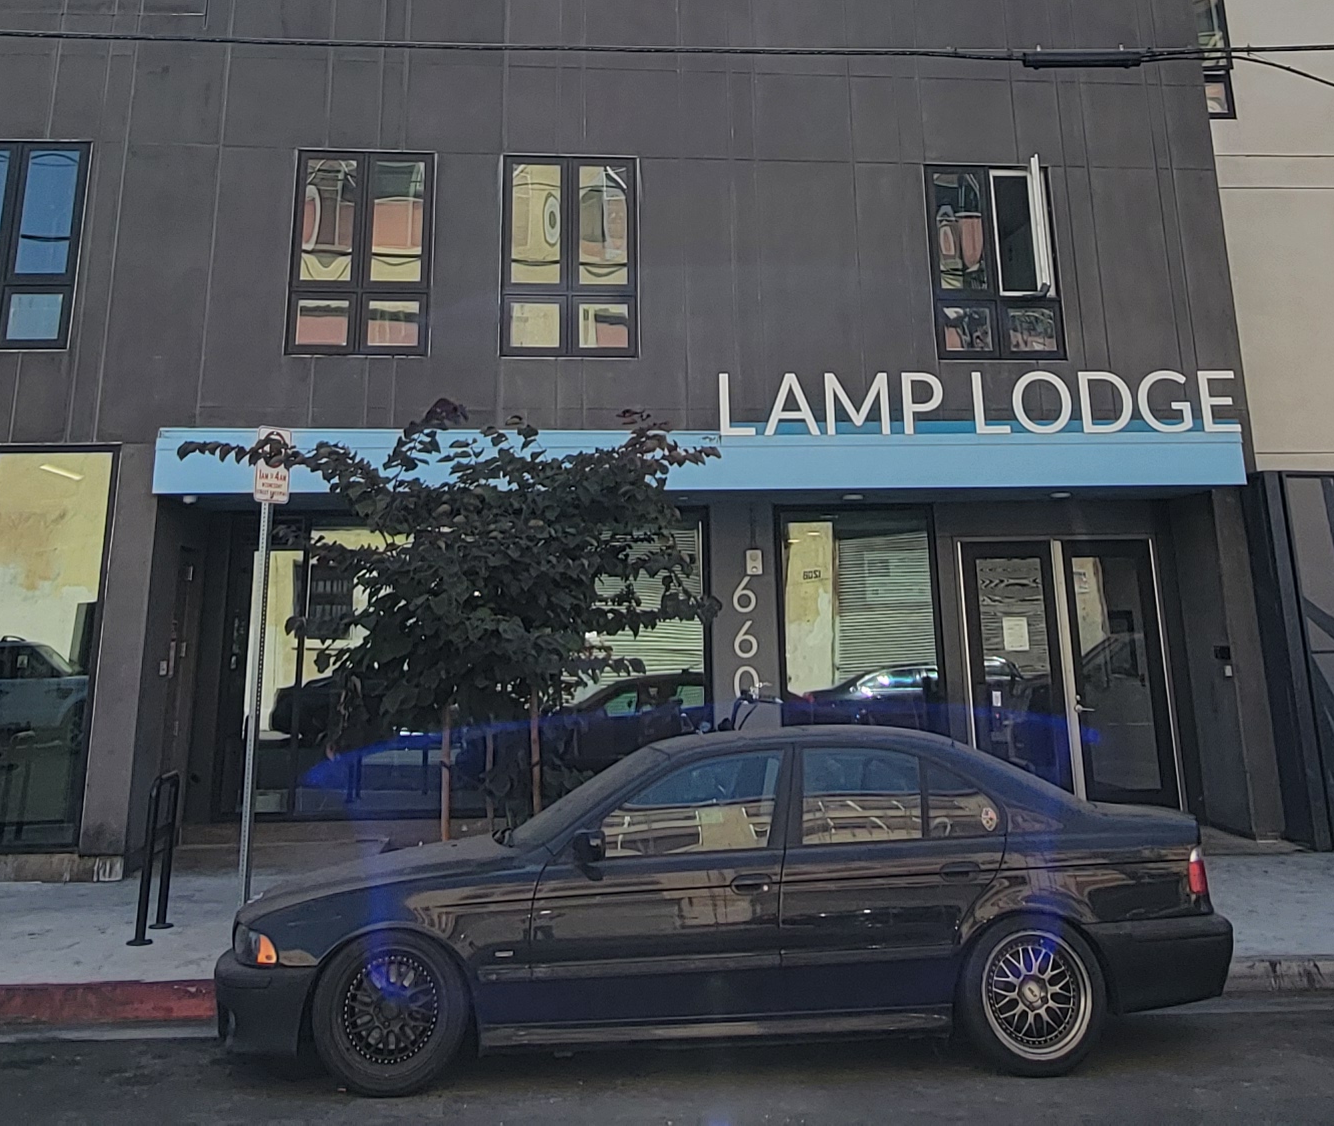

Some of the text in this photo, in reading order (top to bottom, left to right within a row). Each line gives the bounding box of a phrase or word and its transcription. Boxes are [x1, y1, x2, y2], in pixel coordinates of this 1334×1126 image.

[718, 369, 1243, 436] LAMP LODGE
[732, 576, 760, 697] 660
